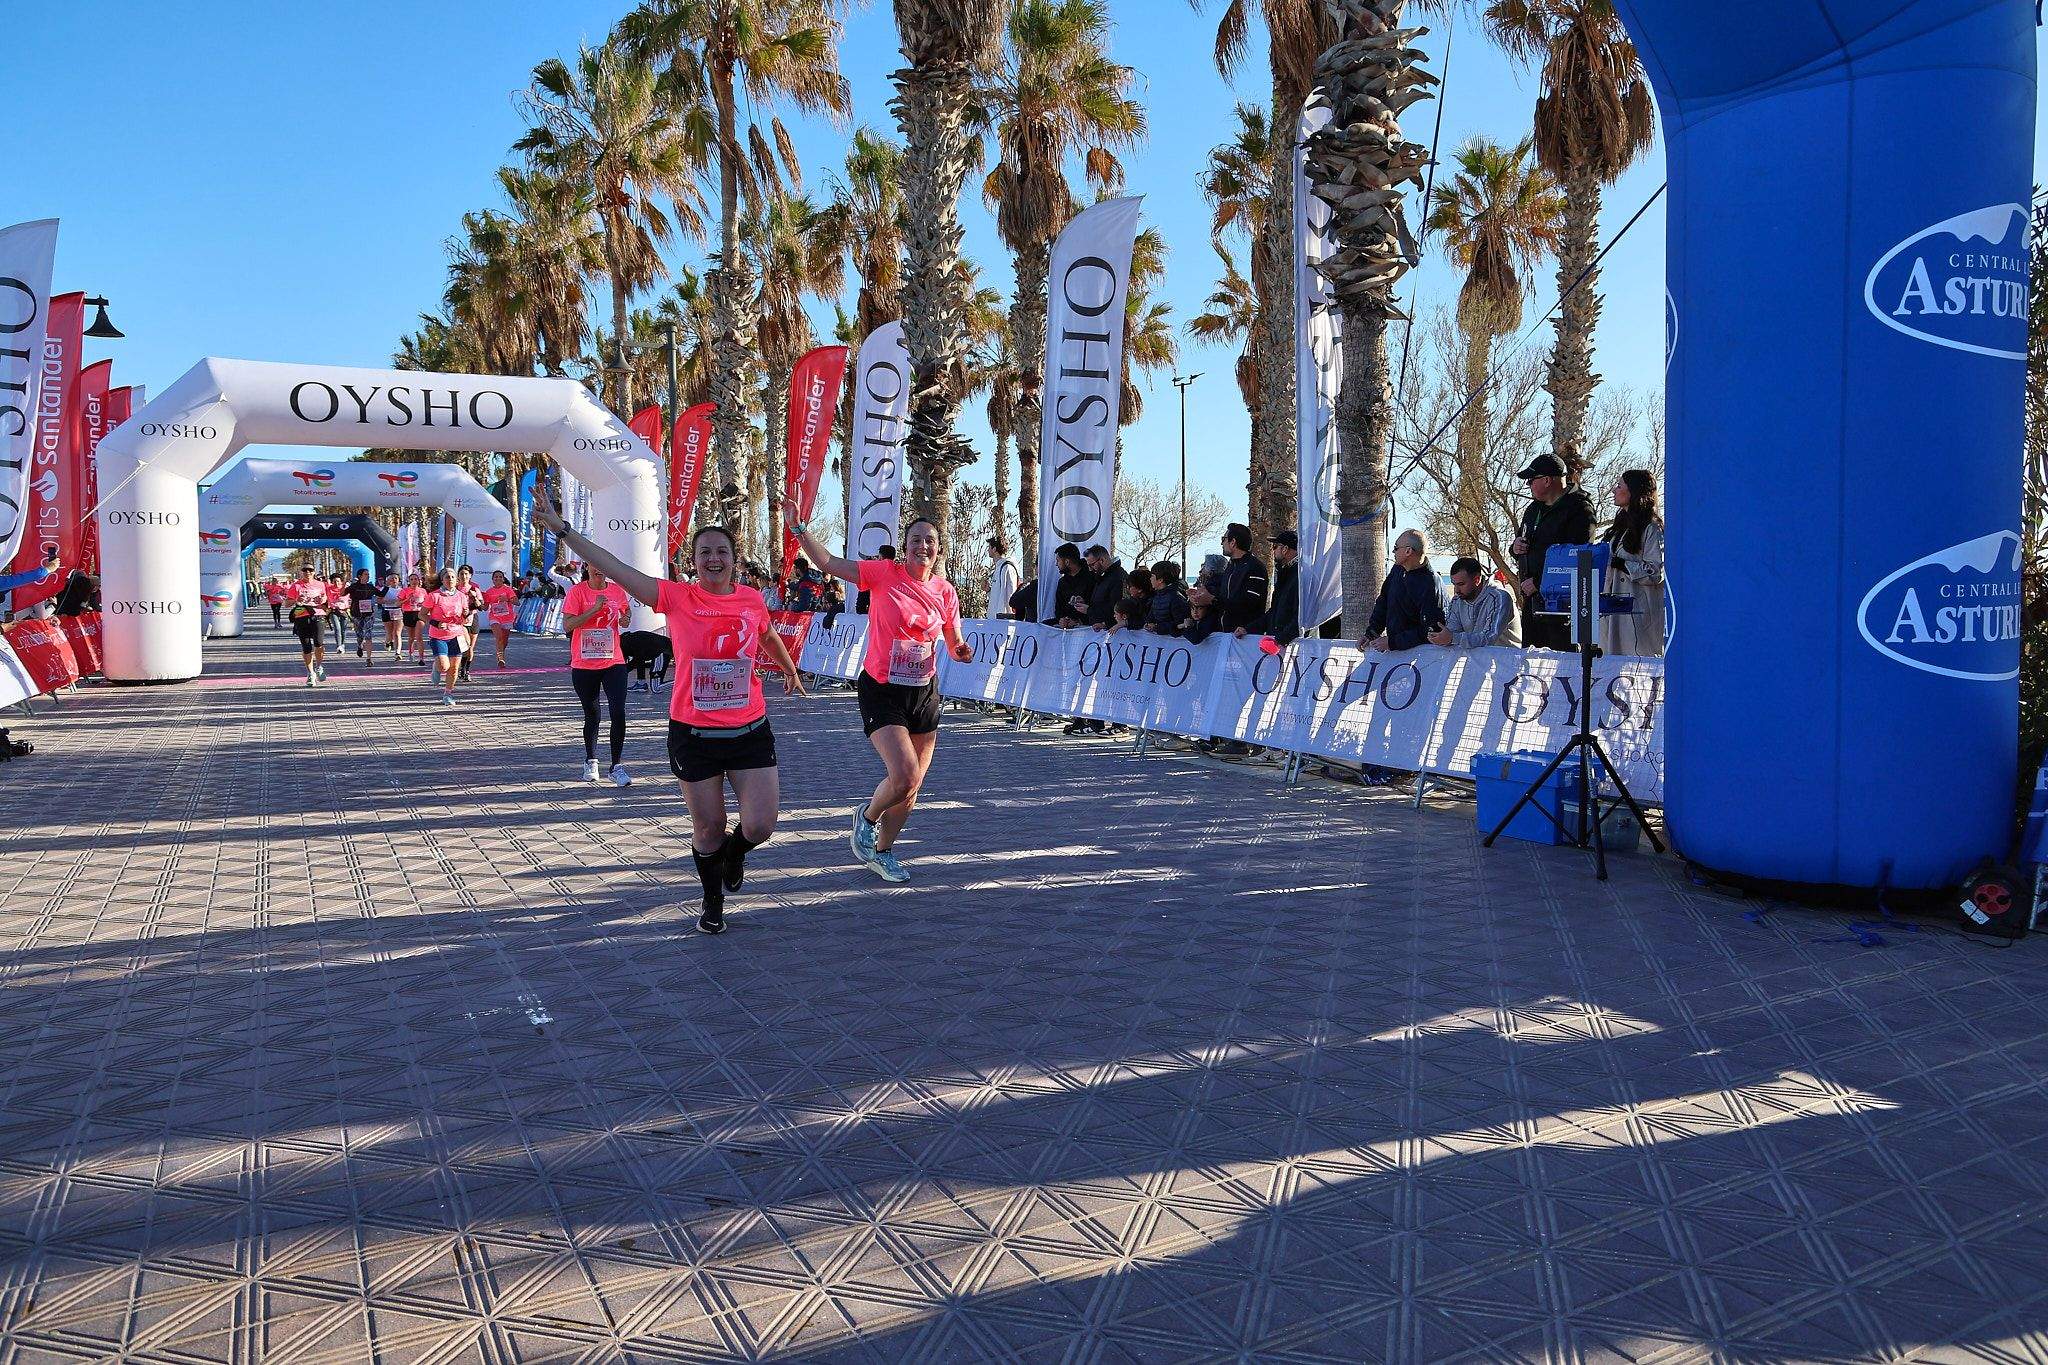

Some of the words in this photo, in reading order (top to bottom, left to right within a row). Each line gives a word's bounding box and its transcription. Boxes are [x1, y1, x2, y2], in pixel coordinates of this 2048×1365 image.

[1949, 253, 2021, 273] CENTRAL
[37, 332, 64, 466] Santander
[289, 381, 514, 430] OYSHO
[1051, 255, 1117, 542] OYSHO
[140, 423, 217, 440] OYSHO
[573, 438, 633, 452] OYSHO
[676, 426, 701, 508] Santander
[858, 361, 902, 560] OYSHO
[109, 510, 180, 527] OYSHO
[263, 522, 350, 531] VOLVO
[608, 518, 662, 532] OYSHO
[1940, 582, 2012, 598] CENTRAL
[111, 600, 182, 615] OYSHO
[907, 661, 926, 670] 016
[1078, 641, 1192, 688] OYSHO
[713, 680, 734, 691] 016
[1251, 652, 1422, 711] OYSHO
